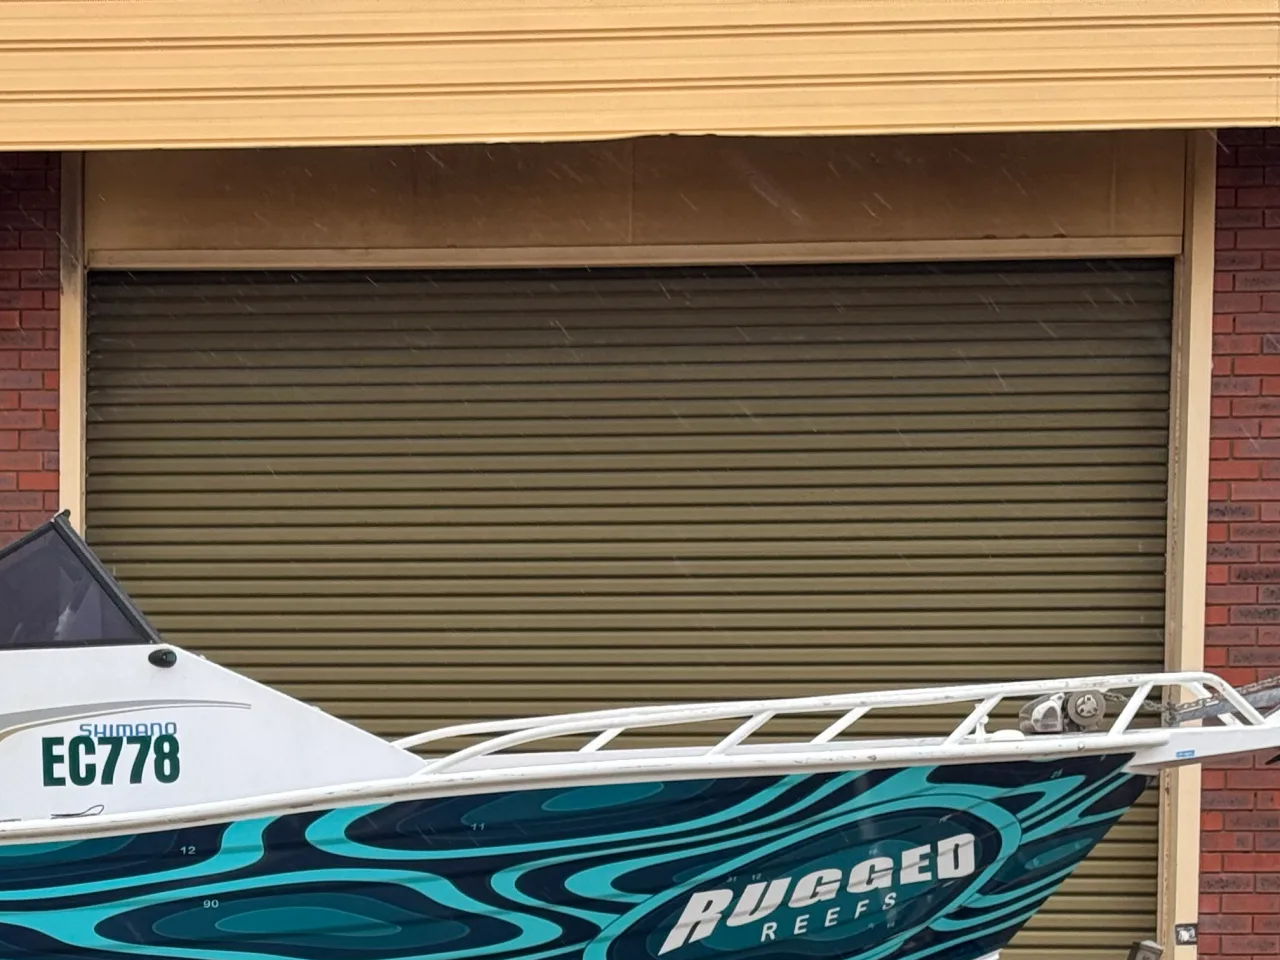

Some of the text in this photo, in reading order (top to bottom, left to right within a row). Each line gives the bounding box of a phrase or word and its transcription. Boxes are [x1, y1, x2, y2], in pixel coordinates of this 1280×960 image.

[79, 721, 178, 738] SHIMANO
[41, 733, 181, 788] EC778
[180, 846, 196, 855] 12
[203, 899, 219, 908] 90
[657, 832, 976, 956] RUGGED
[759, 891, 898, 943] REEFS
